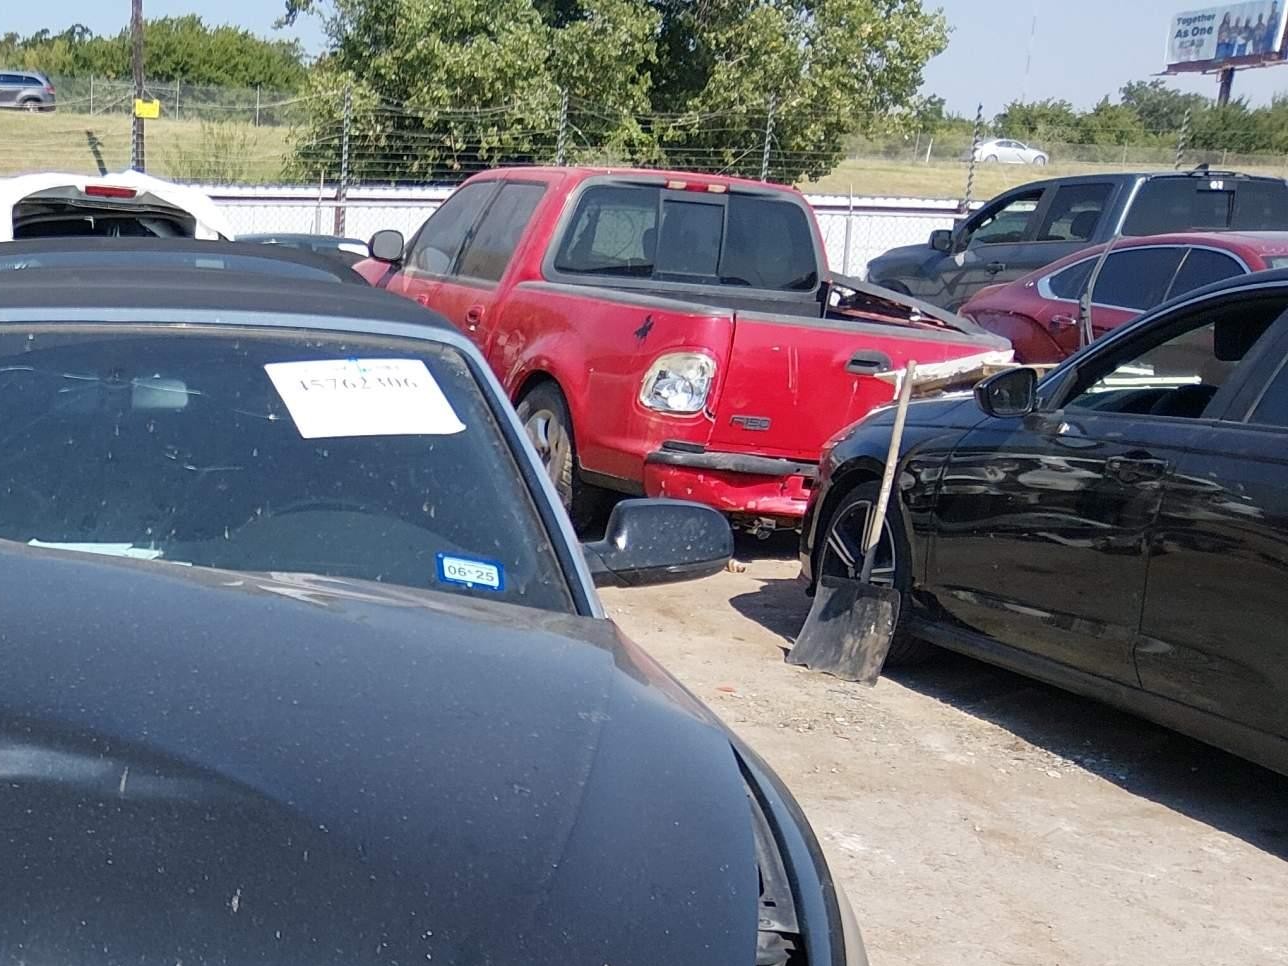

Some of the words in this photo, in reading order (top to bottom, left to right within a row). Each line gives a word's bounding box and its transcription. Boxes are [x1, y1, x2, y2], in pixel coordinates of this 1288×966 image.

[1176, 13, 1216, 26] Together
[1174, 29, 1189, 39] As
[1191, 26, 1214, 37] One
